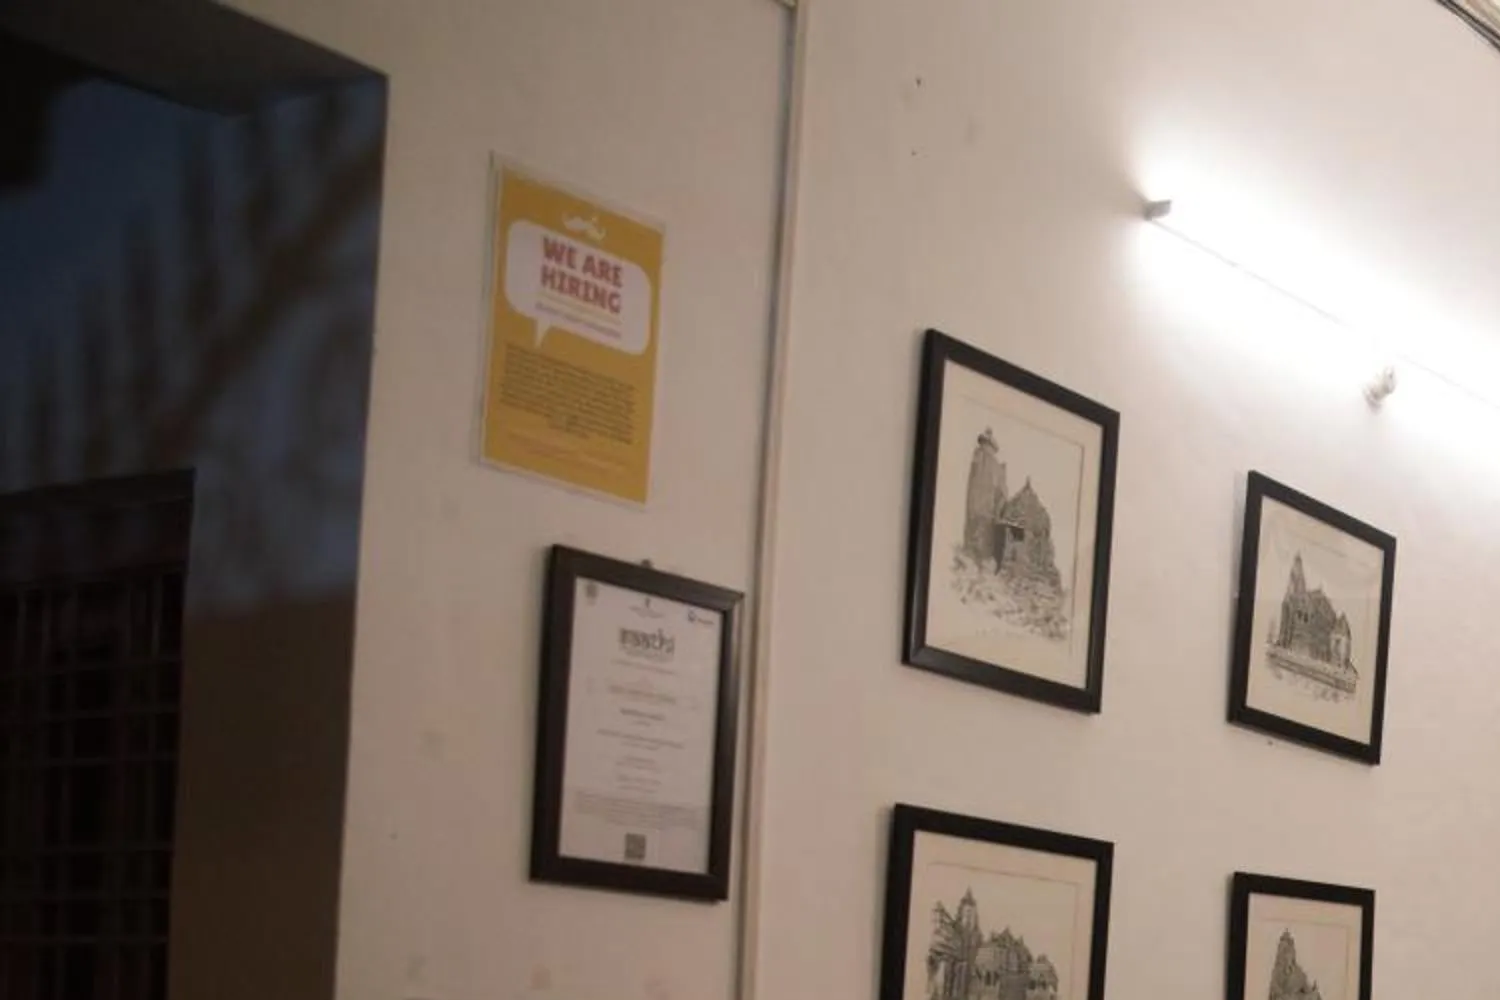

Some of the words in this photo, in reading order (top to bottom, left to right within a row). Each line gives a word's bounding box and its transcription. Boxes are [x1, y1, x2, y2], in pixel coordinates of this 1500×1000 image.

[543, 237, 577, 269] WE
[583, 255, 623, 288] ARE
[541, 264, 622, 314] HIRING
